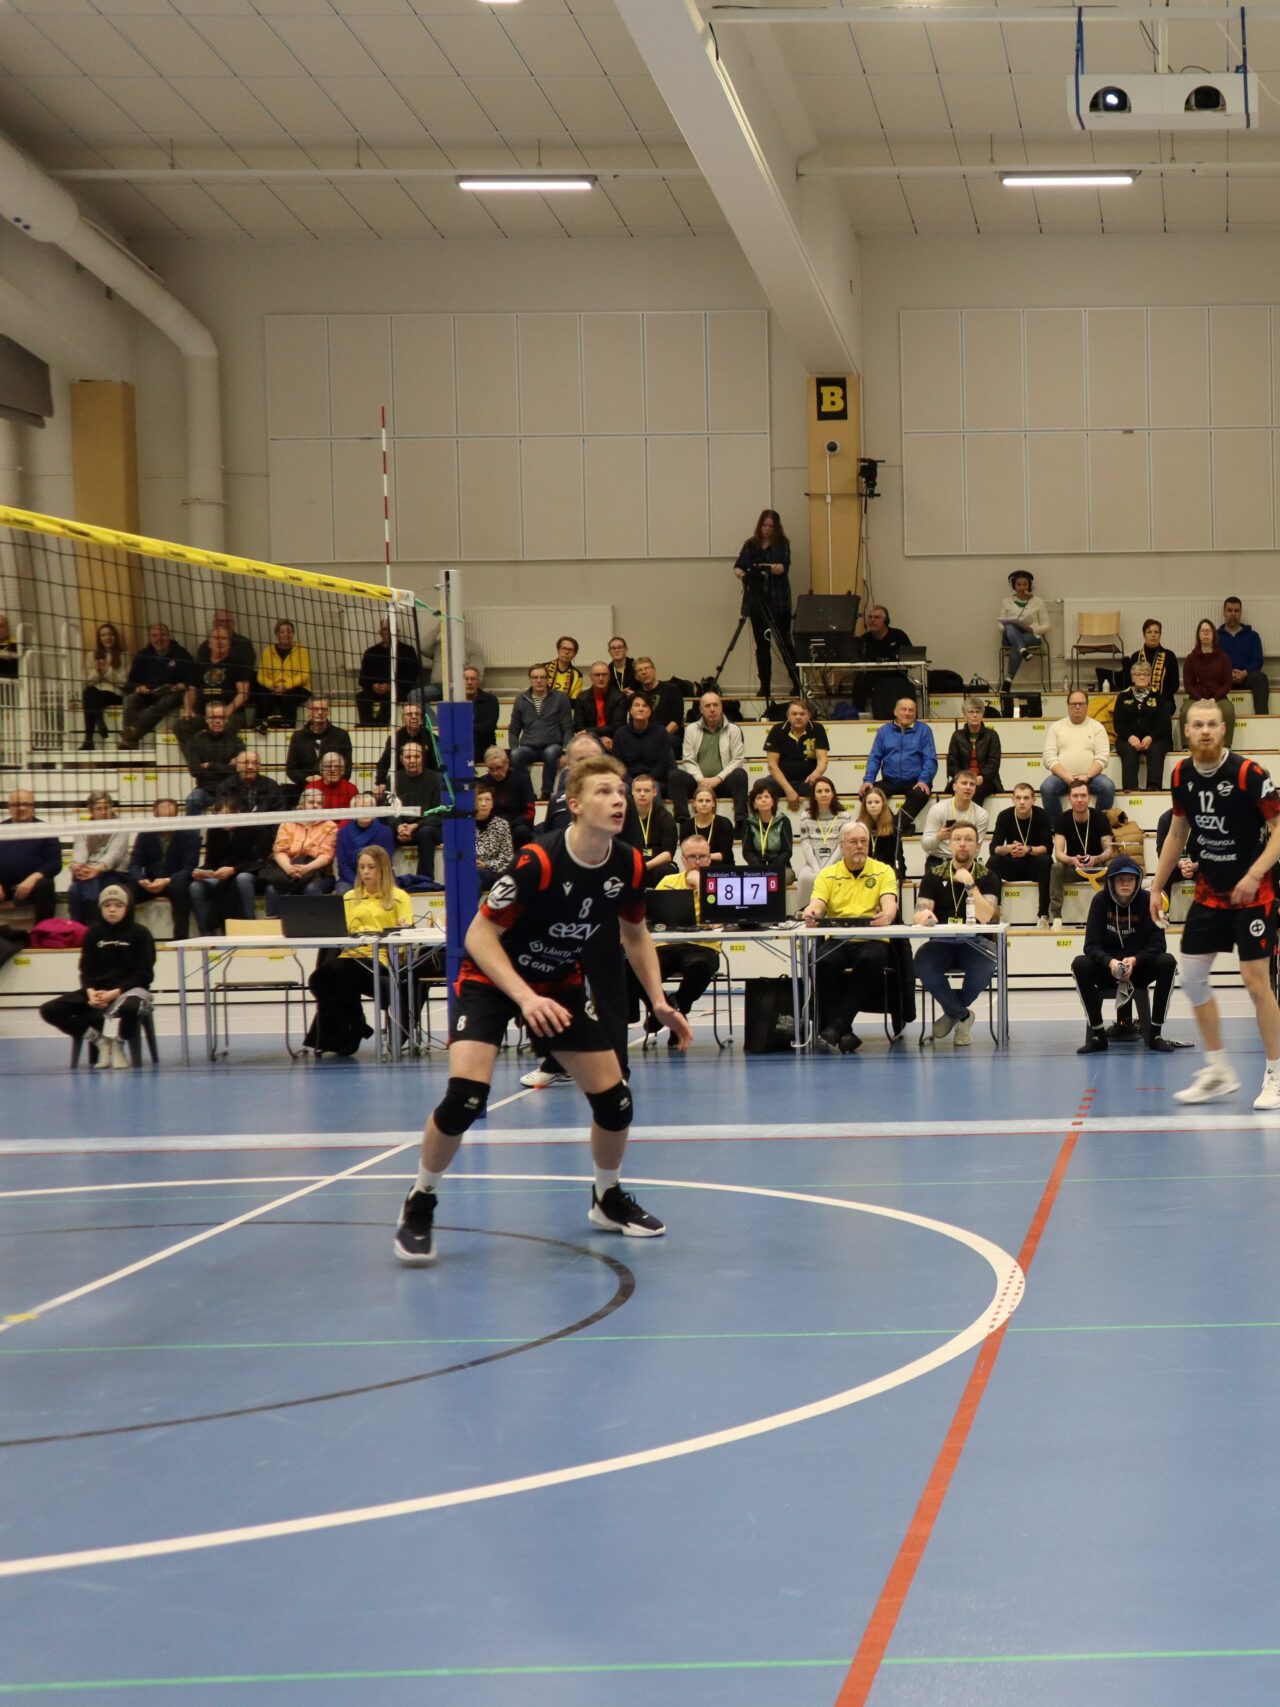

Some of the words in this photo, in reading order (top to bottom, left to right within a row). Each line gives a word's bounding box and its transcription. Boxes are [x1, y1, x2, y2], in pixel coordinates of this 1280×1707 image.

[820, 385, 844, 412] B
[1198, 790, 1215, 813] 12
[1195, 815, 1229, 834] eezy
[708, 881, 715, 890] 0
[724, 884, 734, 900] 8
[750, 883, 760, 900] 7
[769, 880, 776, 889] 0
[578, 897, 593, 919] 8
[456, 1015, 466, 1031] 8
